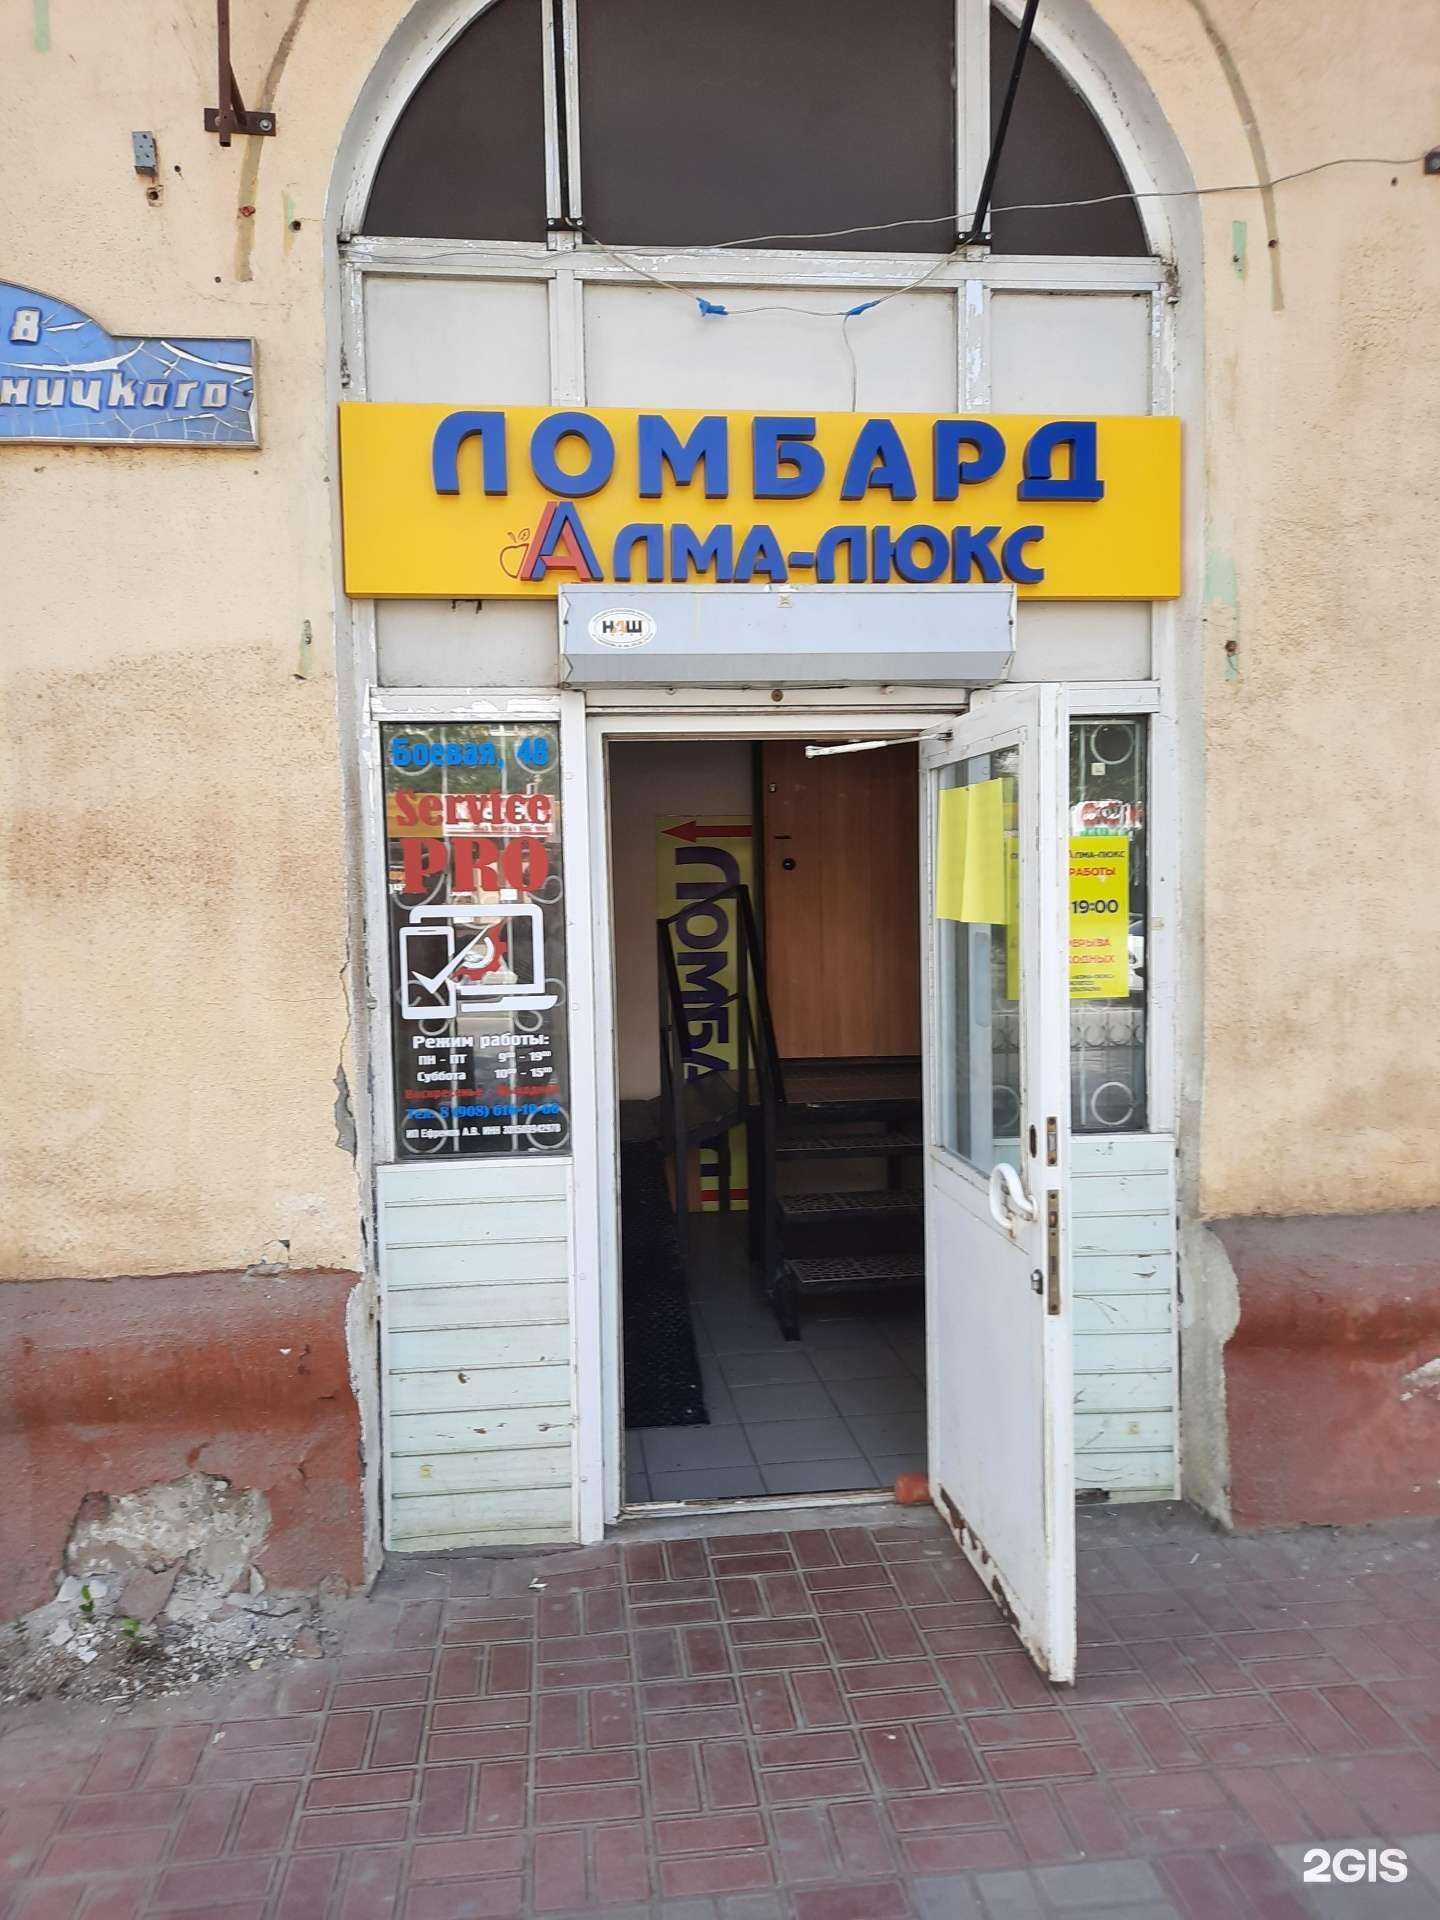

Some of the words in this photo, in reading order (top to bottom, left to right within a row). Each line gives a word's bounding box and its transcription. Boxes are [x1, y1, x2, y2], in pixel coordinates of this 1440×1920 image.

[432, 410, 1104, 502] ЛОМБАРД
[520, 500, 1045, 584] АЛМА-ЛЮКС
[391, 736, 505, 769] Боевая,
[516, 735, 549, 767] 48
[396, 788, 551, 826] Service
[402, 837, 549, 894] PRO
[1069, 867, 1115, 876] РАБОТЫ
[1071, 899, 1119, 914] 19:00
[412, 1035, 474, 1049] Режим
[480, 1033, 550, 1050] работы:
[416, 1070, 467, 1083] Суббота
